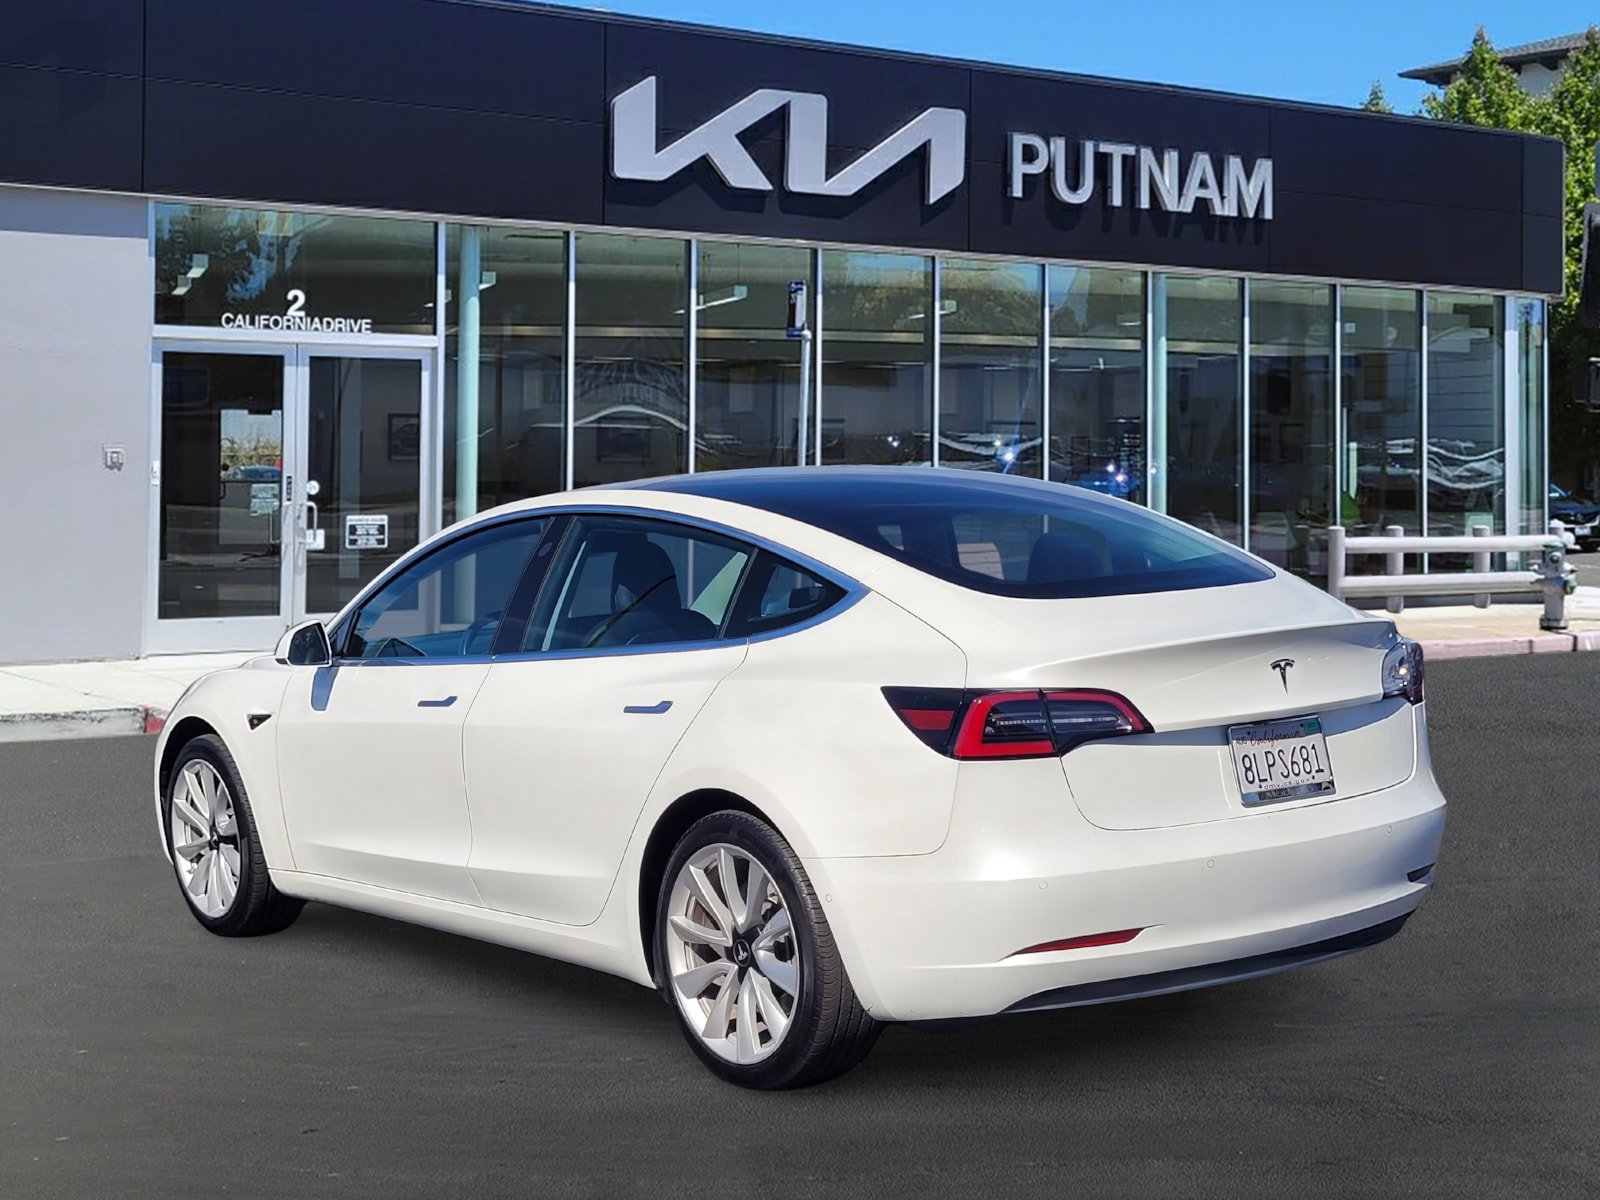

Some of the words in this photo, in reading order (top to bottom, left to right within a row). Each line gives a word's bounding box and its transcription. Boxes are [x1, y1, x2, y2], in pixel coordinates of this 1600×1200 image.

[1007, 131, 1273, 220] PUTNAM
[286, 288, 306, 317] 2
[1250, 728, 1300, 748] California
[1241, 743, 1325, 785] 8LPS681
[1263, 777, 1310, 791] dmv.ca.gov
